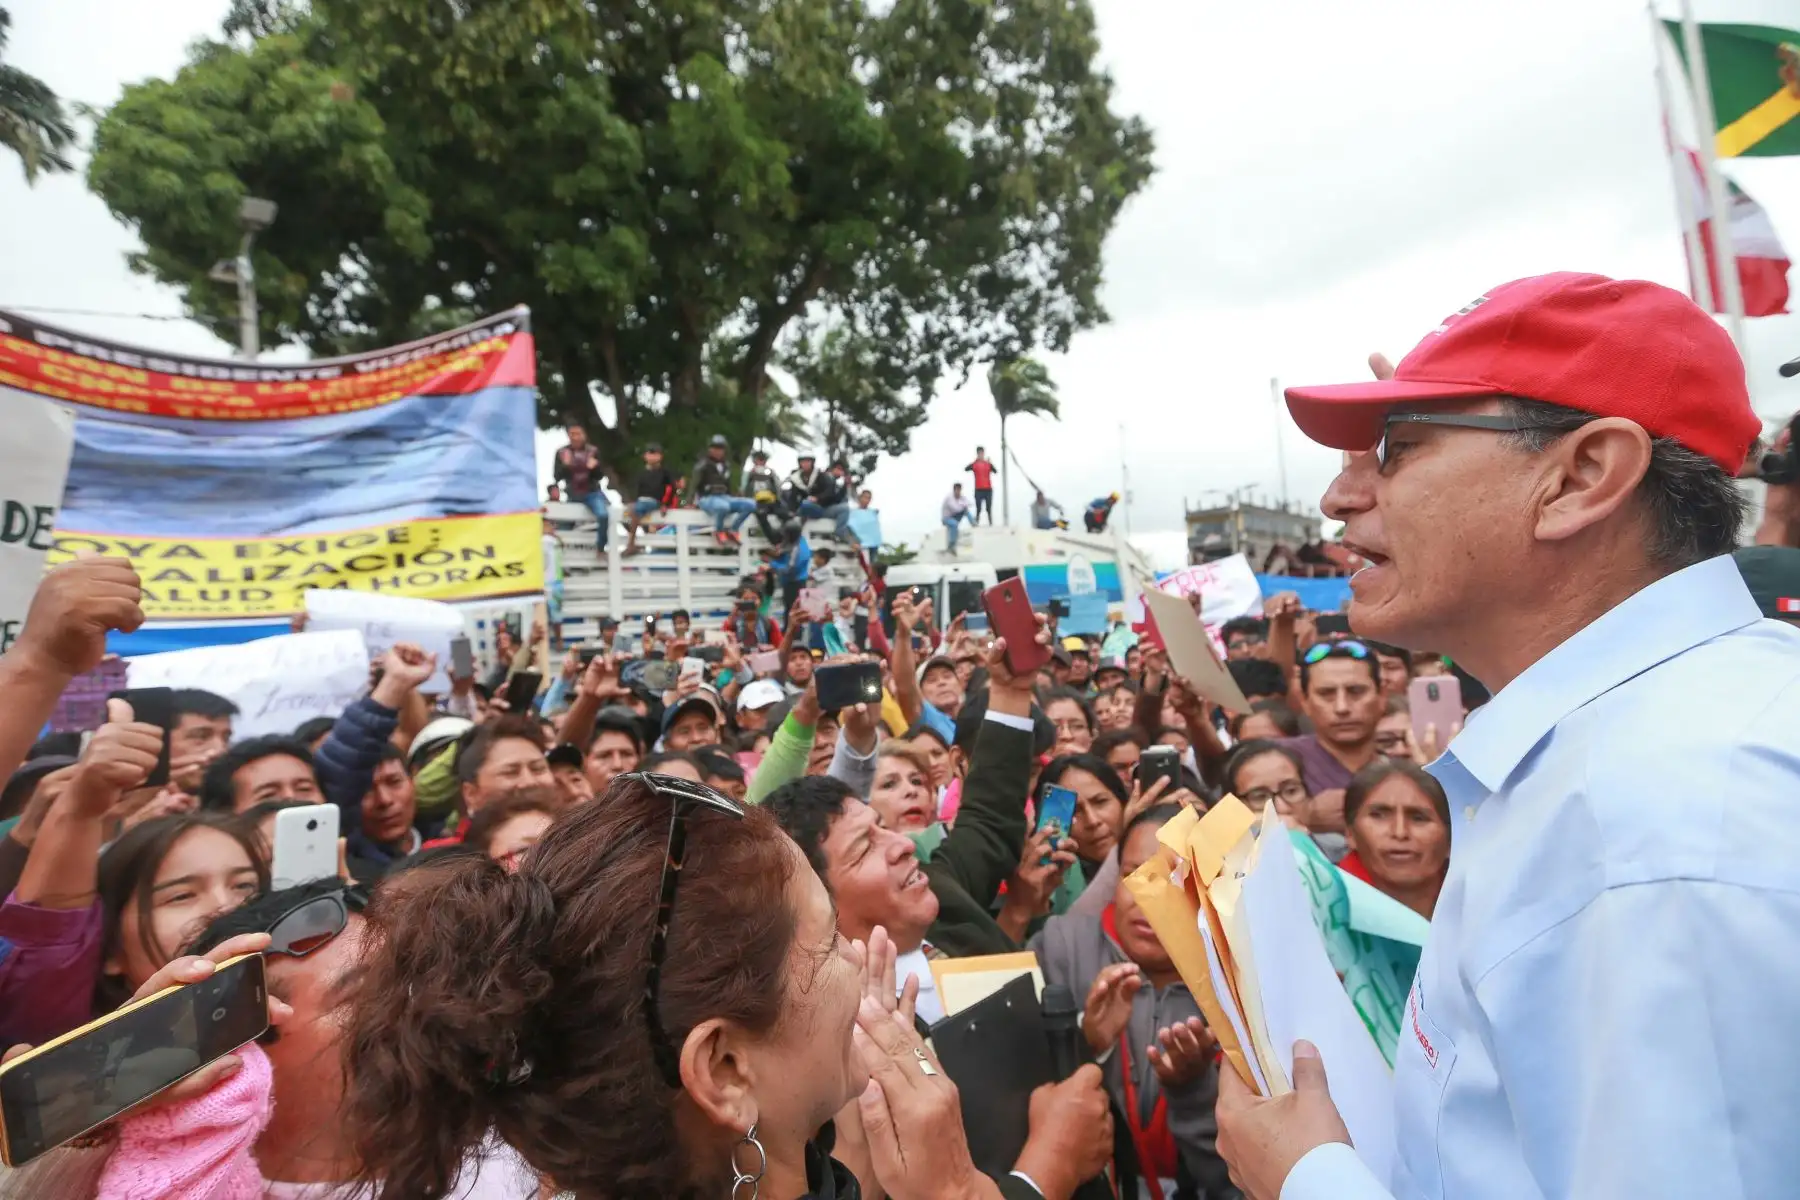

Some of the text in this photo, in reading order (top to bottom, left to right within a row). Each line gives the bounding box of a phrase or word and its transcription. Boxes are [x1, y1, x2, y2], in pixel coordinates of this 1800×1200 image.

[0, 500, 54, 551] DE
[133, 544, 496, 583] ALIZACIÓN
[371, 561, 526, 591] HORAS
